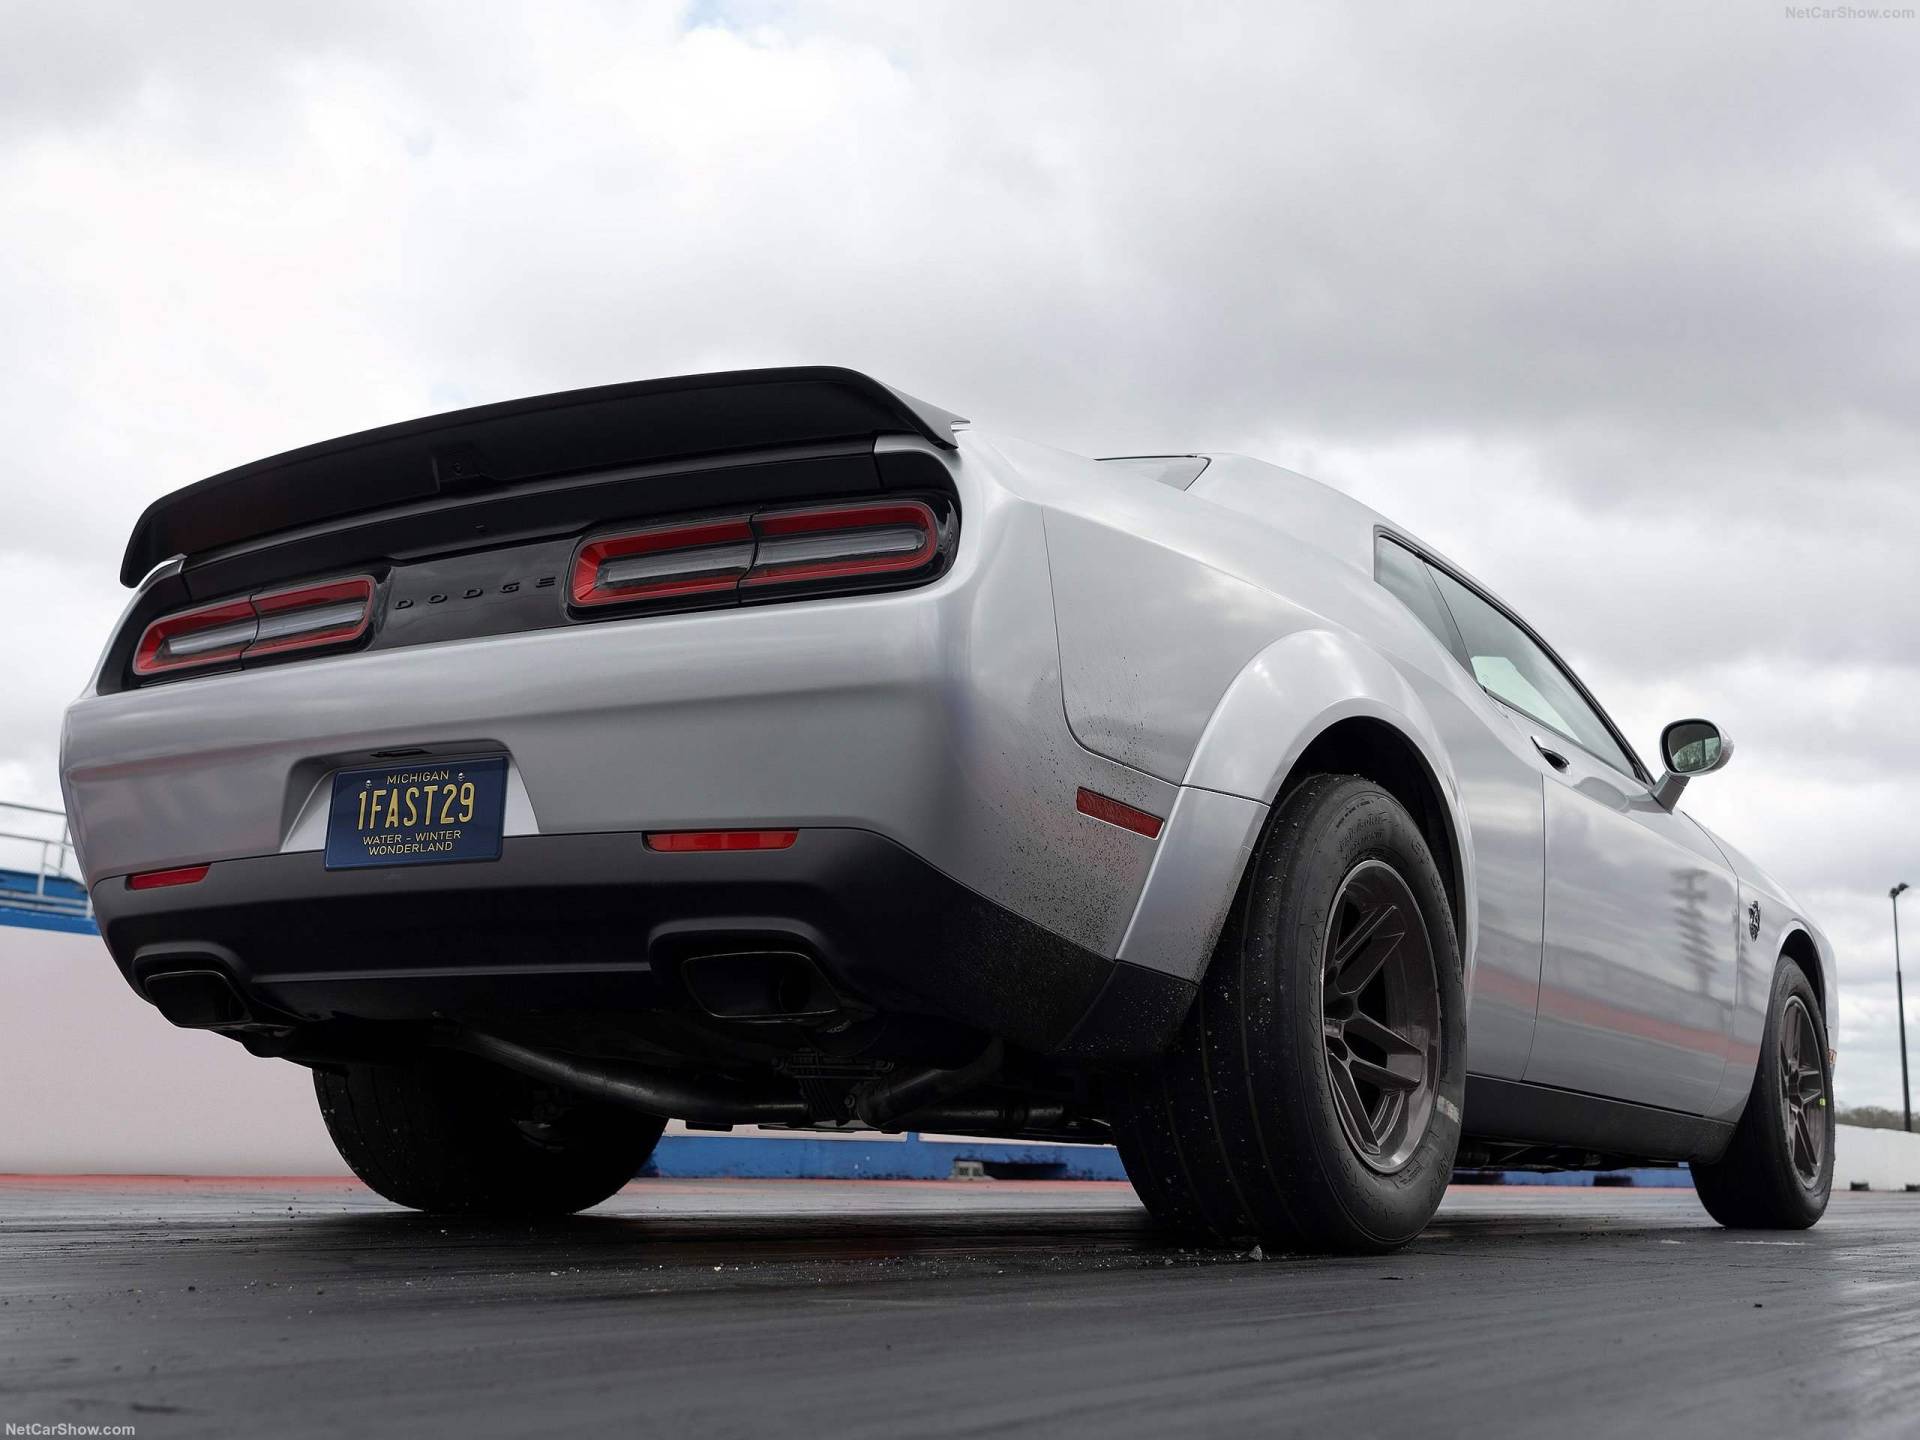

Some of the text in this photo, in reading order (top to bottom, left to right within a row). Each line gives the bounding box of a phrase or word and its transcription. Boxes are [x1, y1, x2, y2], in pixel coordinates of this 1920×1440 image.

[394, 576, 556, 610] DODGE
[387, 771, 449, 784] MICHIGAN
[357, 782, 475, 830] 1FAST29
[363, 835, 402, 845] WATER
[415, 830, 461, 842] WINTER
[368, 842, 453, 855] WONDERLAND
